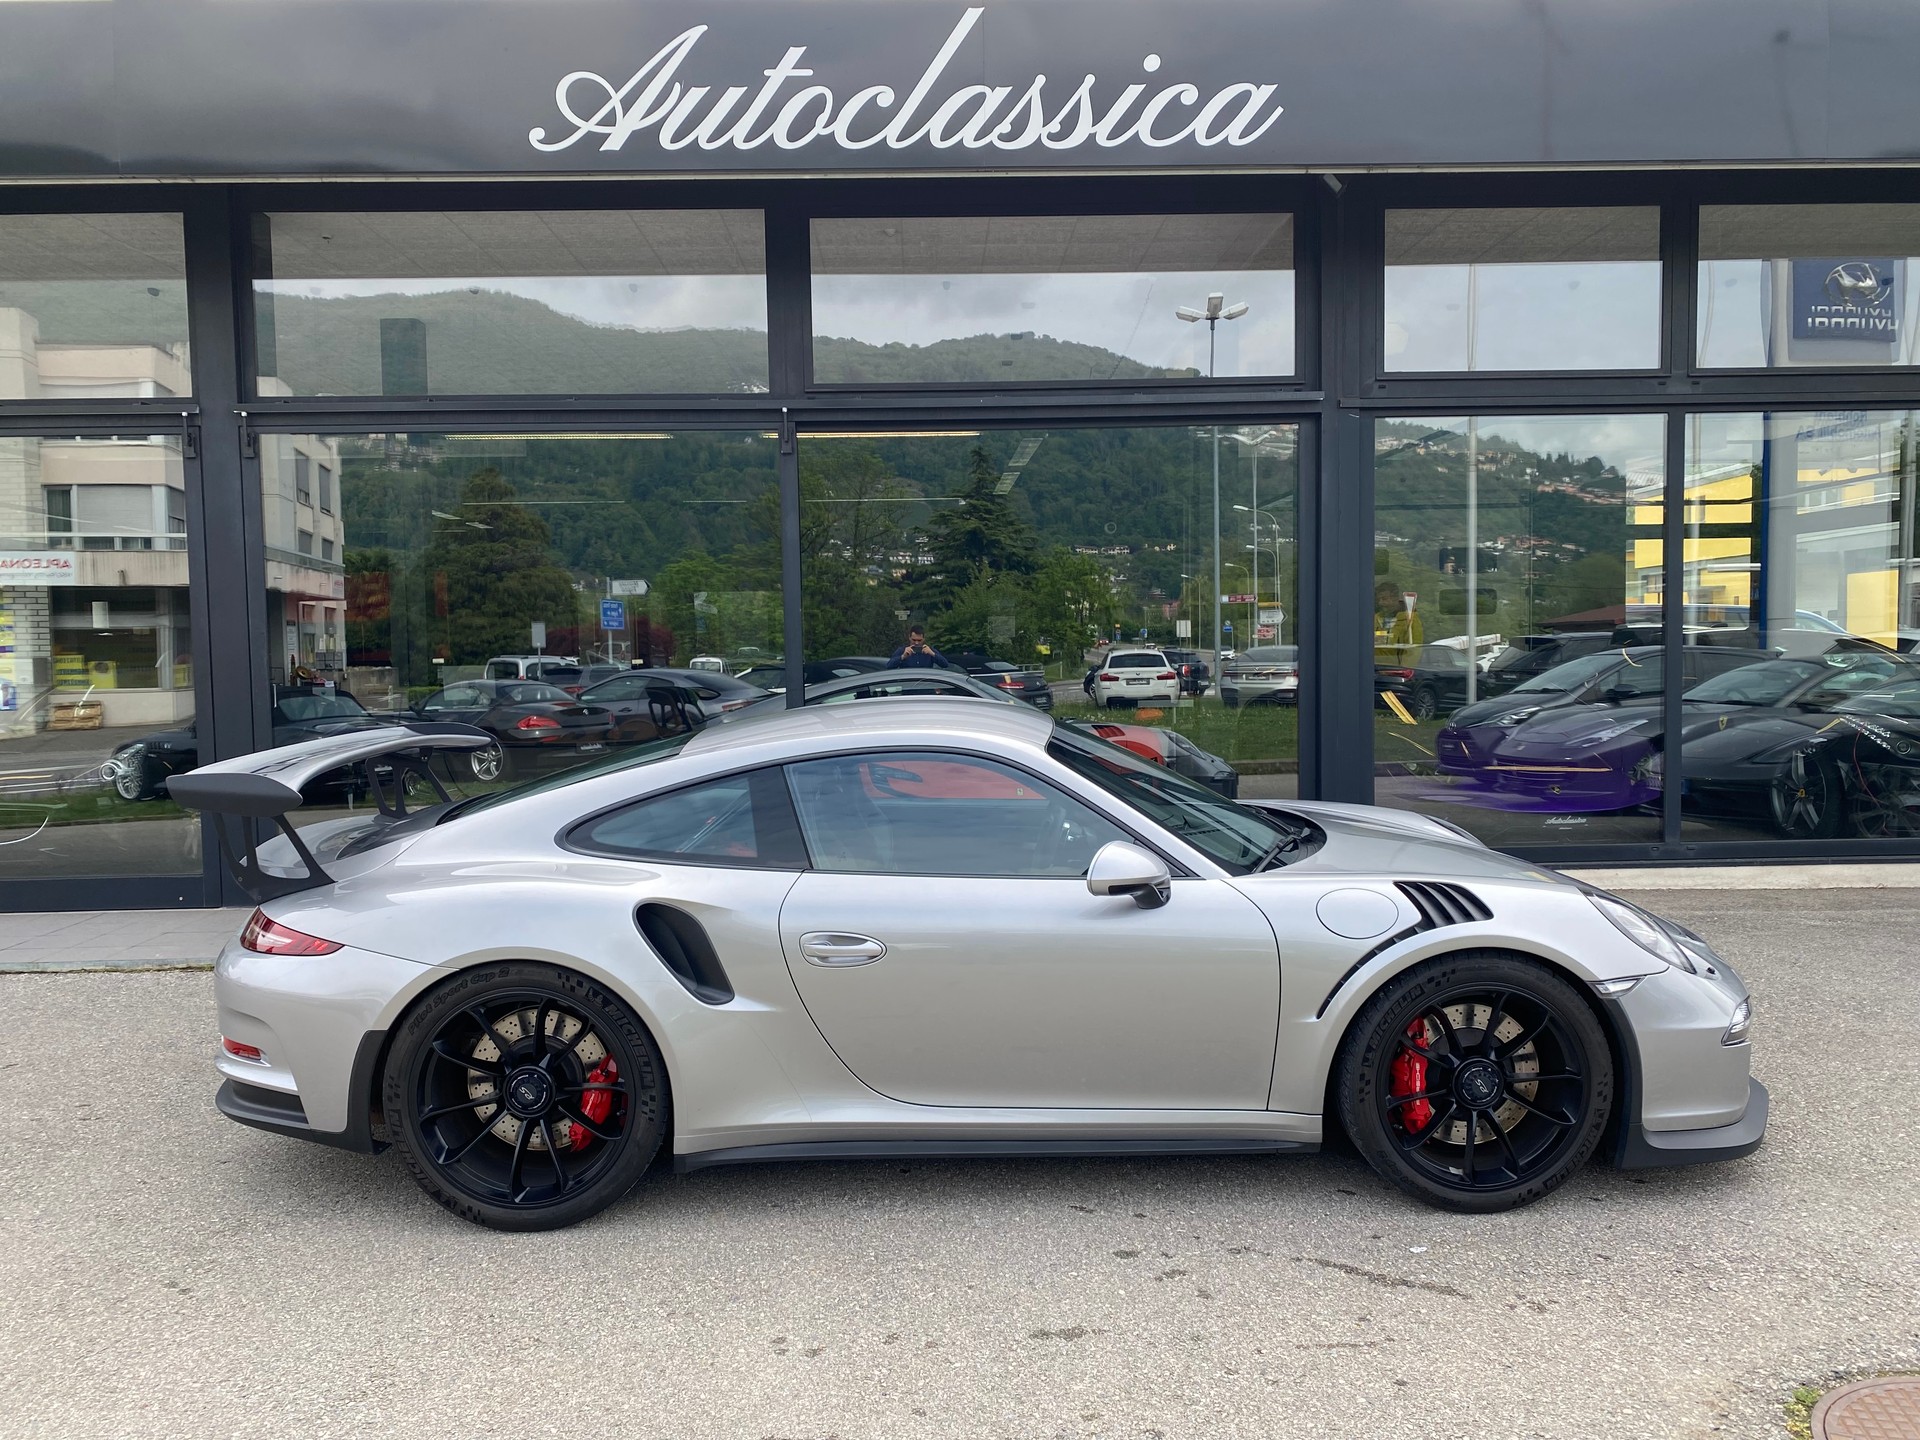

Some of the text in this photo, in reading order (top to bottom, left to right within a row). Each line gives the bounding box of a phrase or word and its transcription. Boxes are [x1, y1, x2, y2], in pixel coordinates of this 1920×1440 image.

[528, 7, 1285, 152] Autoclassica
[407, 966, 511, 1036] Pilot Sport Cup 2
[1369, 984, 1425, 1049] MICHELIN
[605, 1004, 656, 1090] MICHELIN
